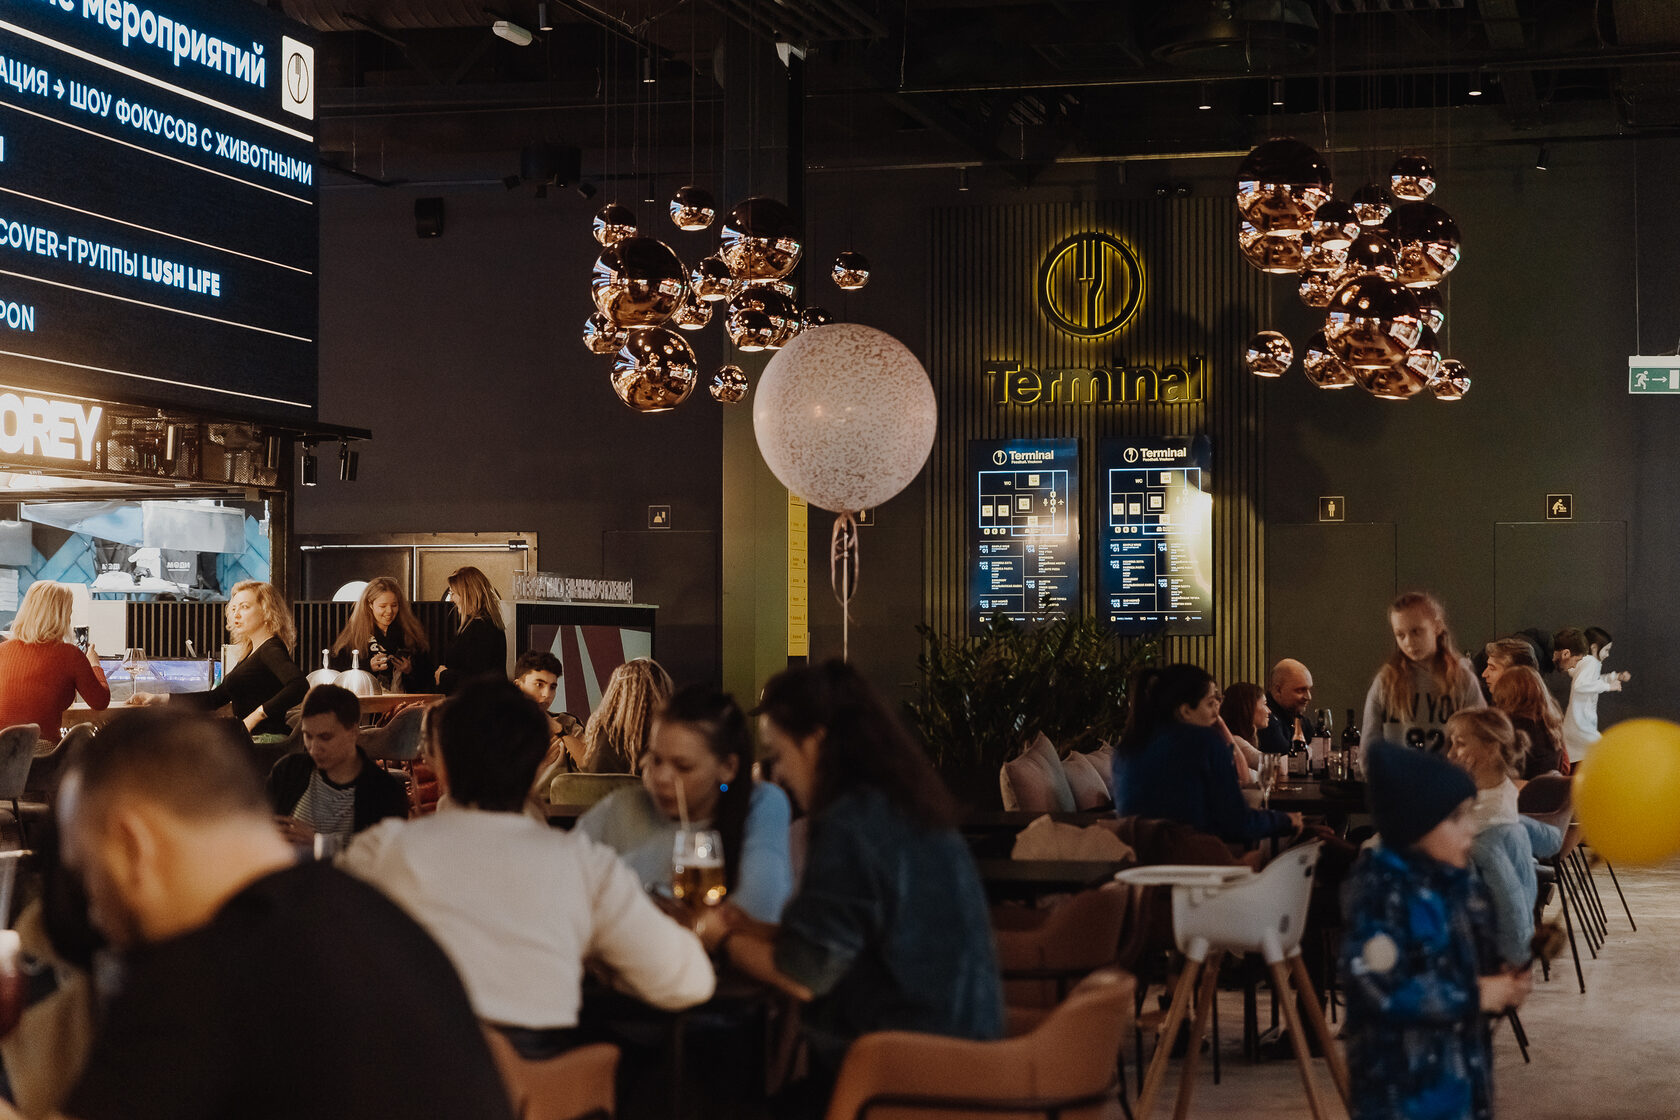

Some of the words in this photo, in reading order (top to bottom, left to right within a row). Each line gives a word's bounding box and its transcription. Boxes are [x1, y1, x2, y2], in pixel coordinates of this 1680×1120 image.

[82, 0, 266, 88] мероприятий
[70, 80, 112, 118] ШОУ
[115, 97, 198, 148] ФОКУСОВ
[201, 127, 213, 152] С
[215, 131, 313, 186] ЖИВОТНЫМИ
[142, 255, 185, 289] LUSH
[188, 267, 221, 297] LIFE
[984, 355, 1204, 405] Terminal
[0, 393, 103, 462] OREY
[1140, 447, 1187, 458] Terminal
[1009, 450, 1054, 460] Terminal
